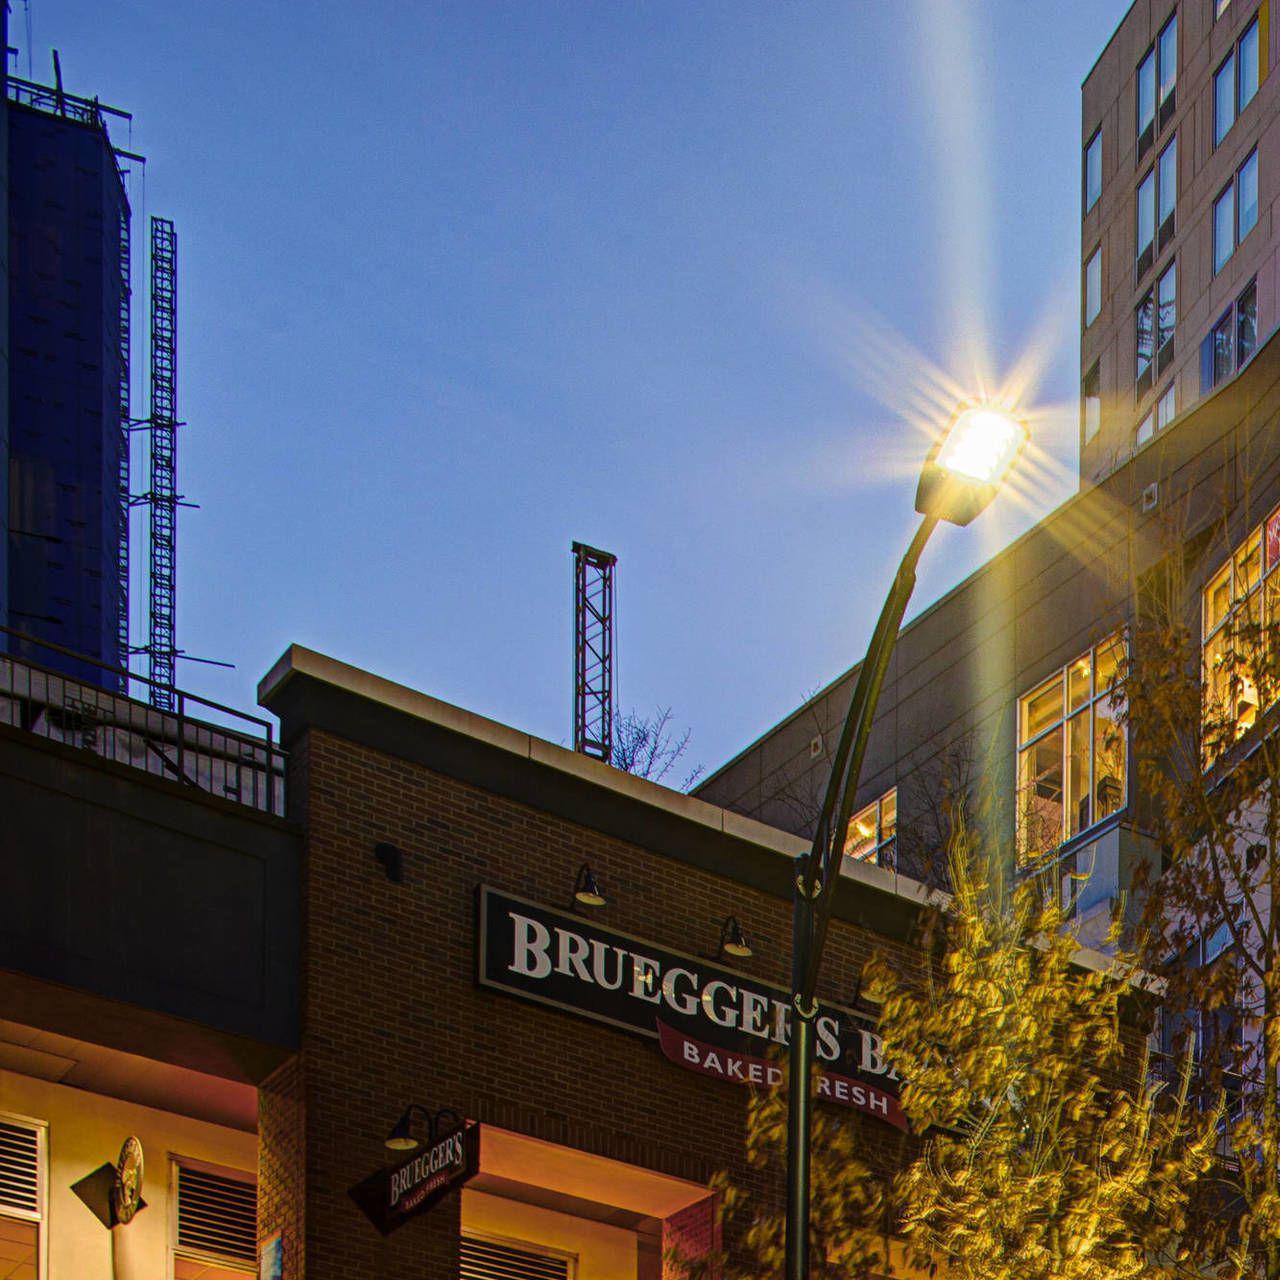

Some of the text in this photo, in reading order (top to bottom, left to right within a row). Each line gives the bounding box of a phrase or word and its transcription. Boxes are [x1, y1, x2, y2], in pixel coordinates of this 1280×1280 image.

[508, 911, 841, 1062] BRUEGGERS
[682, 1041, 888, 1116] BAKED RESH
[390, 1131, 463, 1207] BRUEGGER'S
